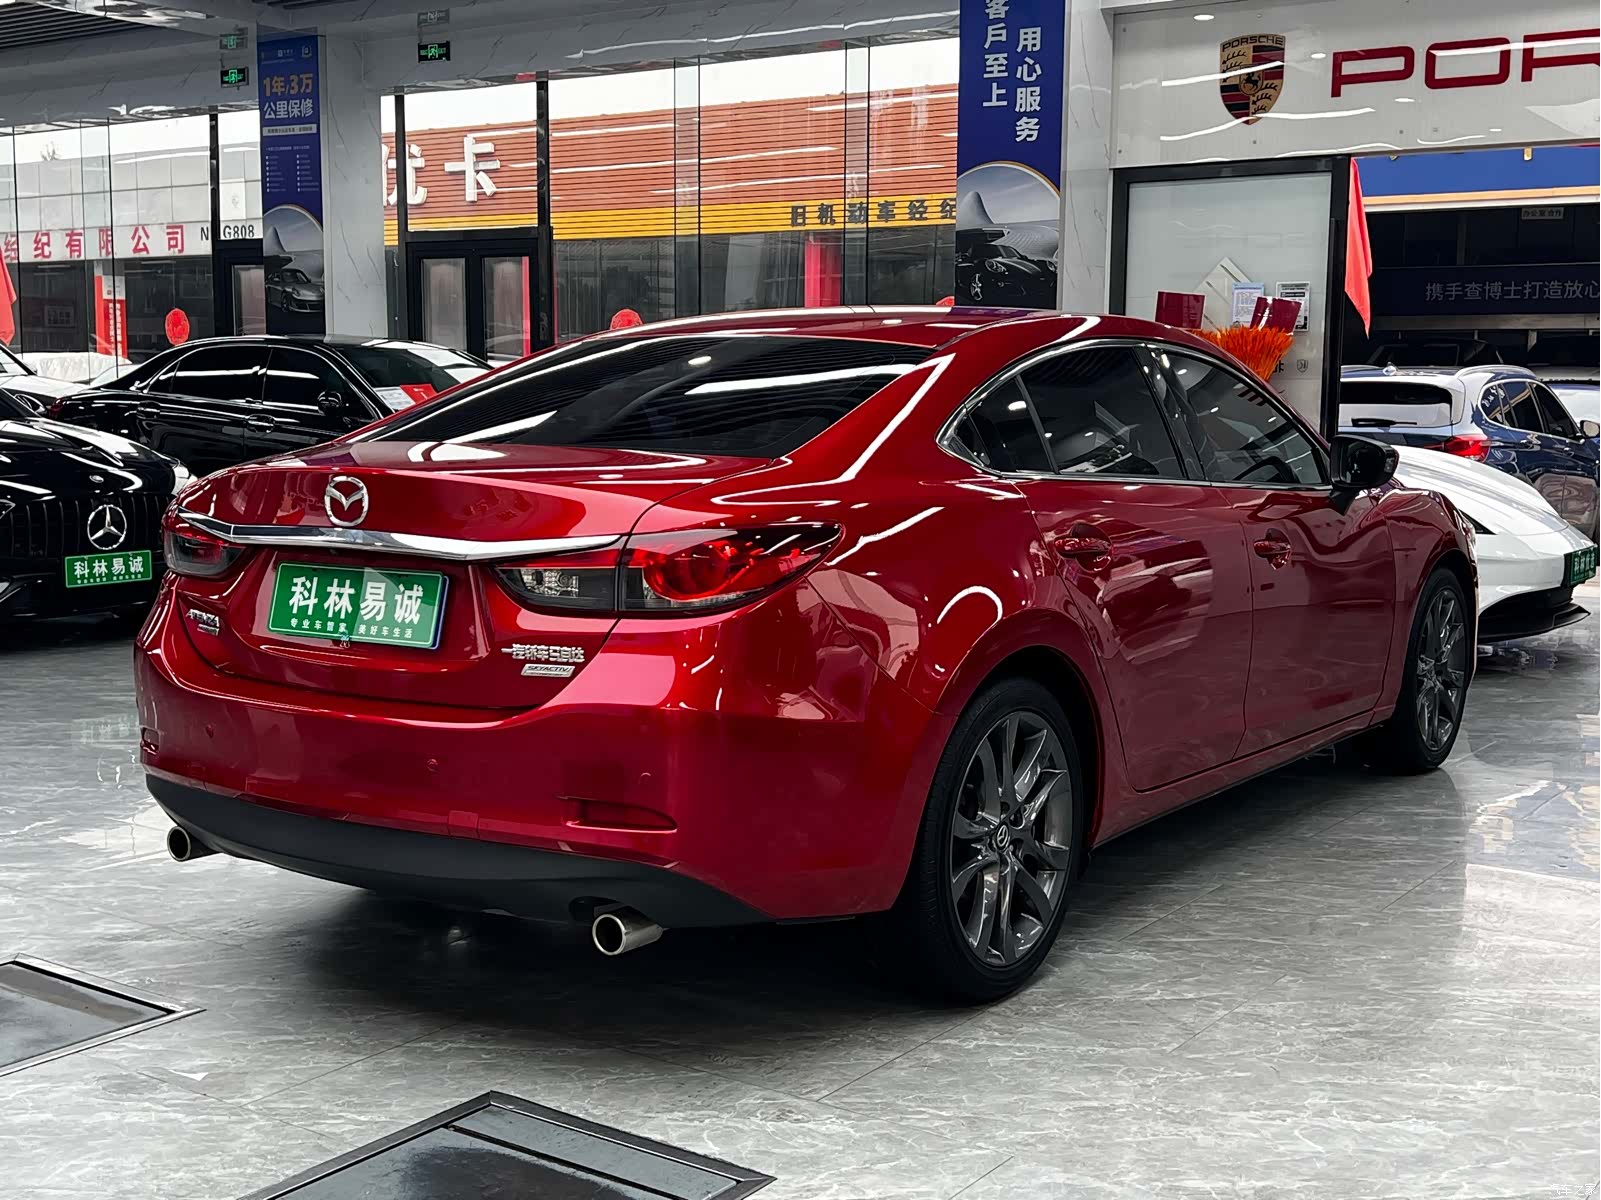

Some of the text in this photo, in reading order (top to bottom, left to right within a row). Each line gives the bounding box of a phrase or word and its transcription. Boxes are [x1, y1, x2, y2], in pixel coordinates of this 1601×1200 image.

[1222, 35, 1284, 52] PORSCHE
[1015, 26, 1042, 142] 用心服务
[263, 98, 314, 119] 公里保修
[223, 224, 255, 239] G808
[1425, 279, 1600, 301] 携手查博士打造放心
[74, 556, 144, 579] 科林易诚
[288, 575, 424, 625] 科林易诚
[290, 618, 413, 638] 专业车管家 美好车生活
